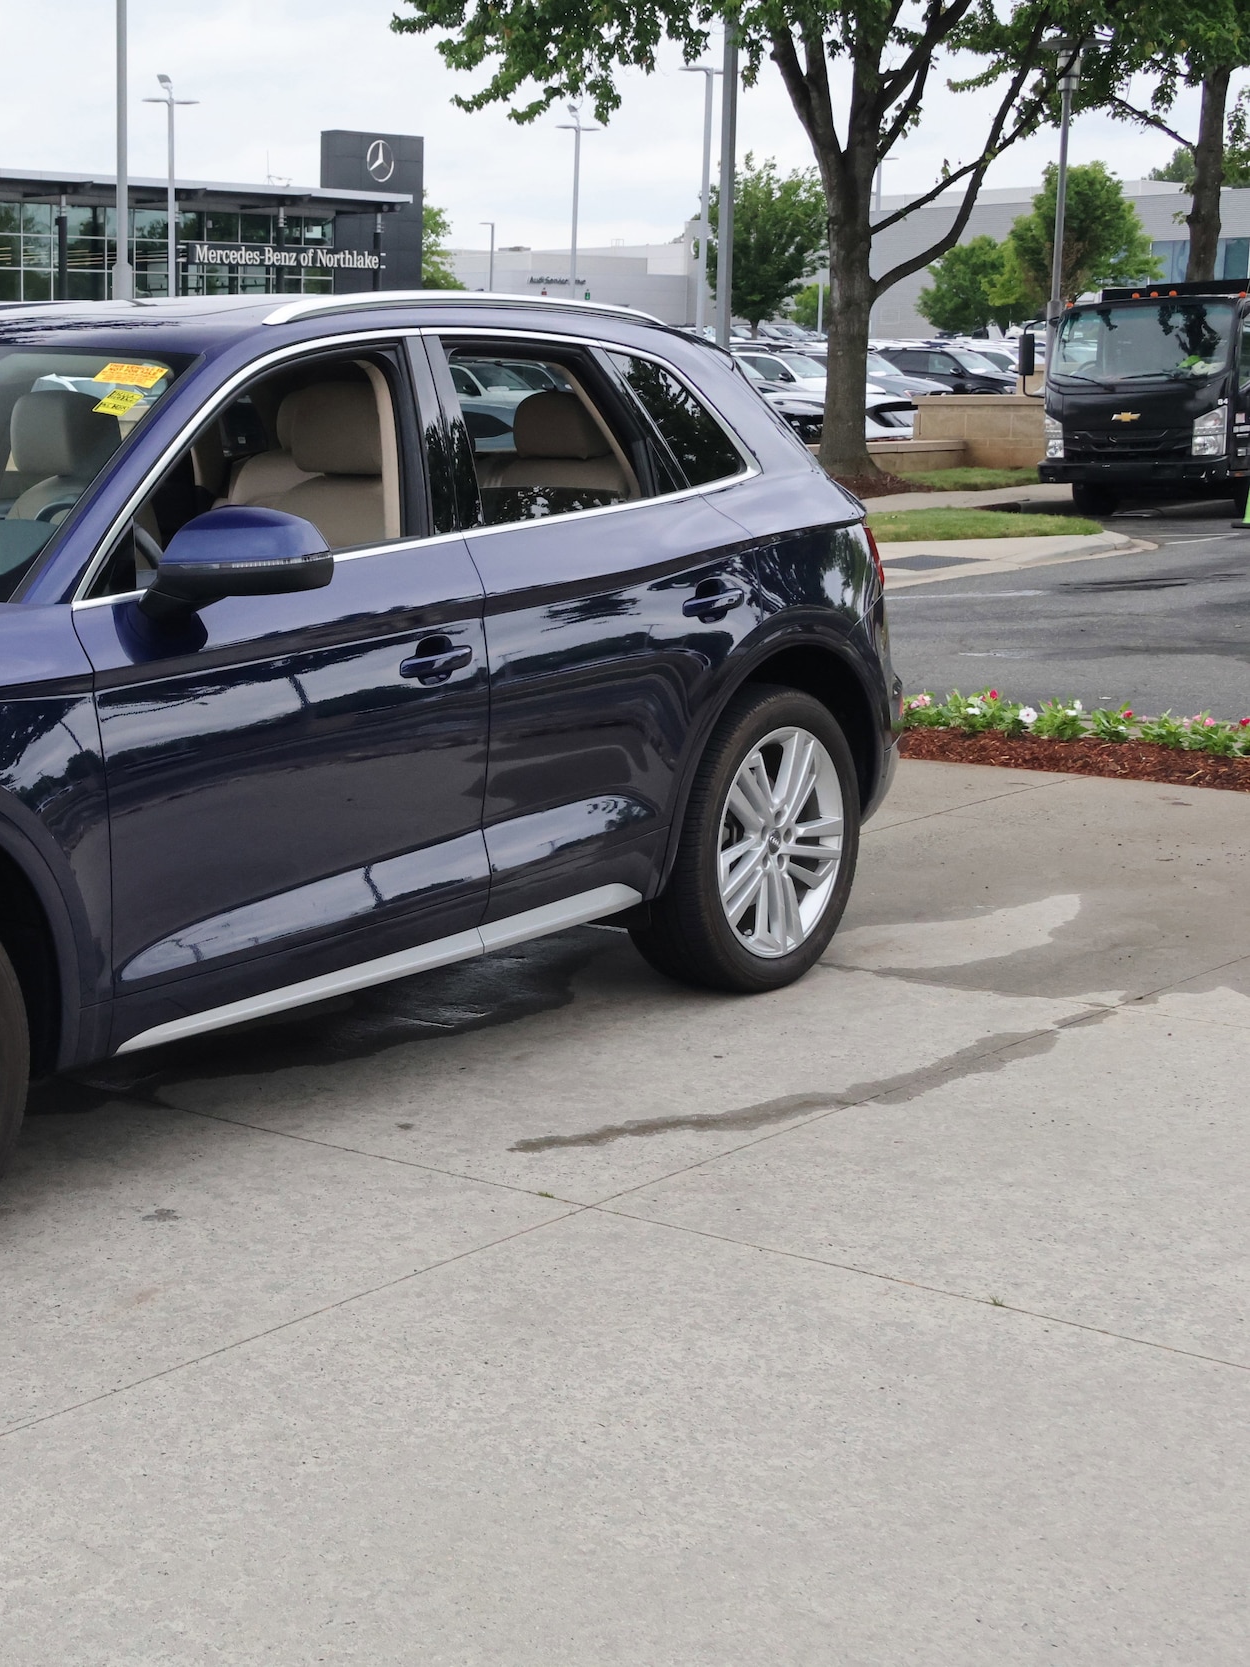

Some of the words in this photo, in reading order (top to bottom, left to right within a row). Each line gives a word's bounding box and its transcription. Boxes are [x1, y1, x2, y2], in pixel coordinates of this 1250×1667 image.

[195, 244, 296, 266] Mercedes-Benz
[300, 249, 314, 267] of
[316, 249, 379, 269] Northlake
